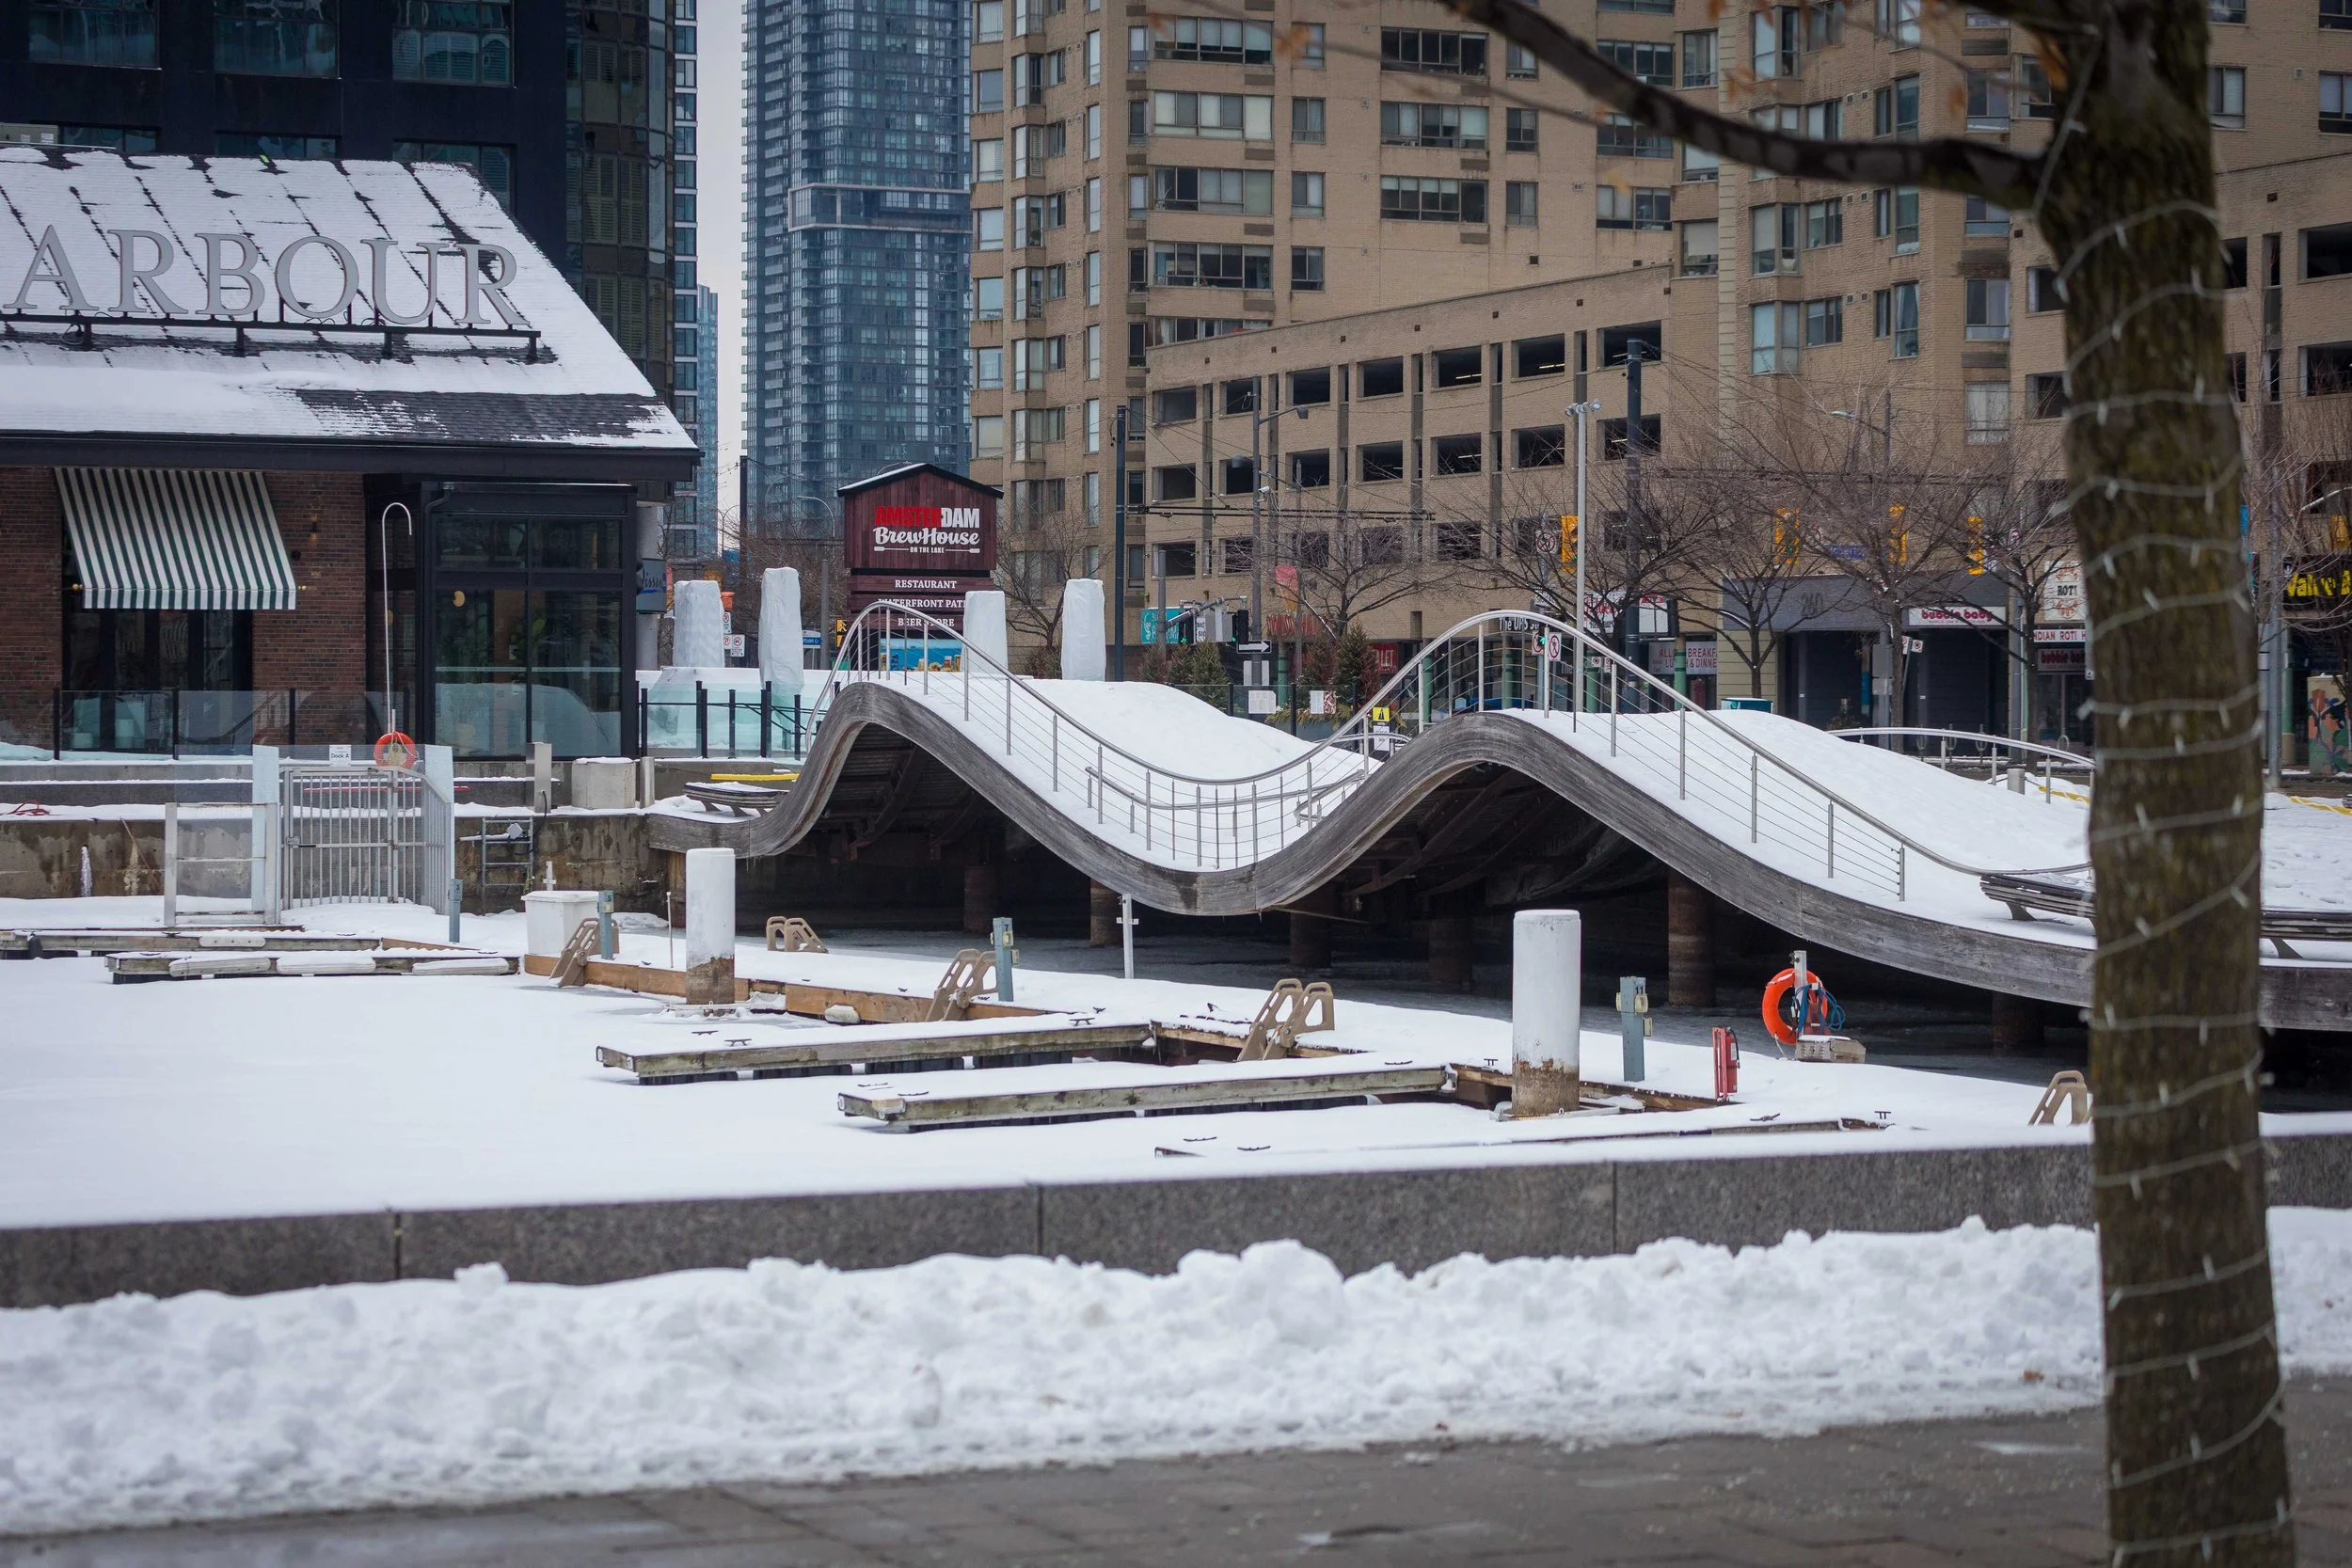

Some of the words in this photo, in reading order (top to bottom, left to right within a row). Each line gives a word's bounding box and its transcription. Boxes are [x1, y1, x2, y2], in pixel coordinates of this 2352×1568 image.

[3, 225, 531, 325] ARBOUR
[875, 506, 980, 528] AMSTERDAM
[873, 527, 980, 546] BrewHouse
[895, 579, 958, 590] RESTAURANT
[2058, 585, 2077, 596] ROTI
[2059, 632, 2077, 641] ROTI
[1688, 648, 1717, 657] BREAKF
[1696, 658, 1717, 668] DINNE
